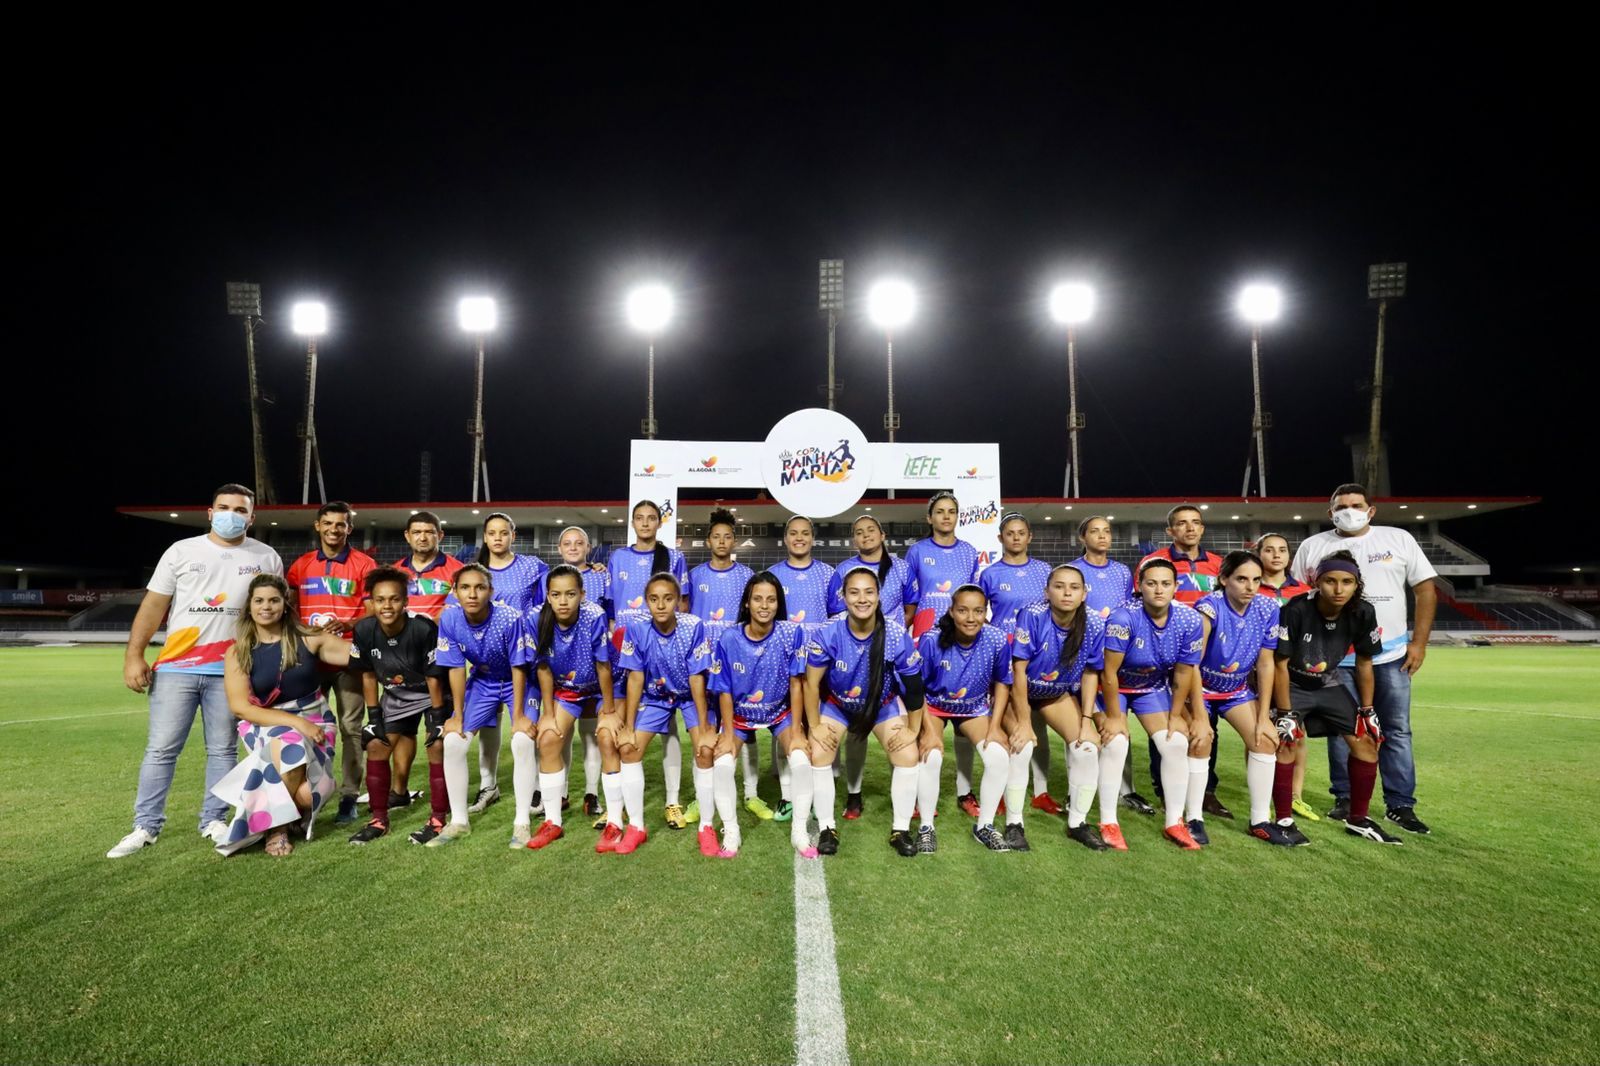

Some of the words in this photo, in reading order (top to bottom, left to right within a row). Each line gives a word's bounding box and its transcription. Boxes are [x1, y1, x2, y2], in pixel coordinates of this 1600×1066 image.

[796, 447, 820, 456] COPA
[782, 451, 835, 471] RAINHA
[780, 460, 843, 487] MARTA
[960, 513, 993, 527] MARTA
[978, 551, 997, 564] AF
[12, 591, 36, 600] smile
[67, 593, 94, 602] Claro
